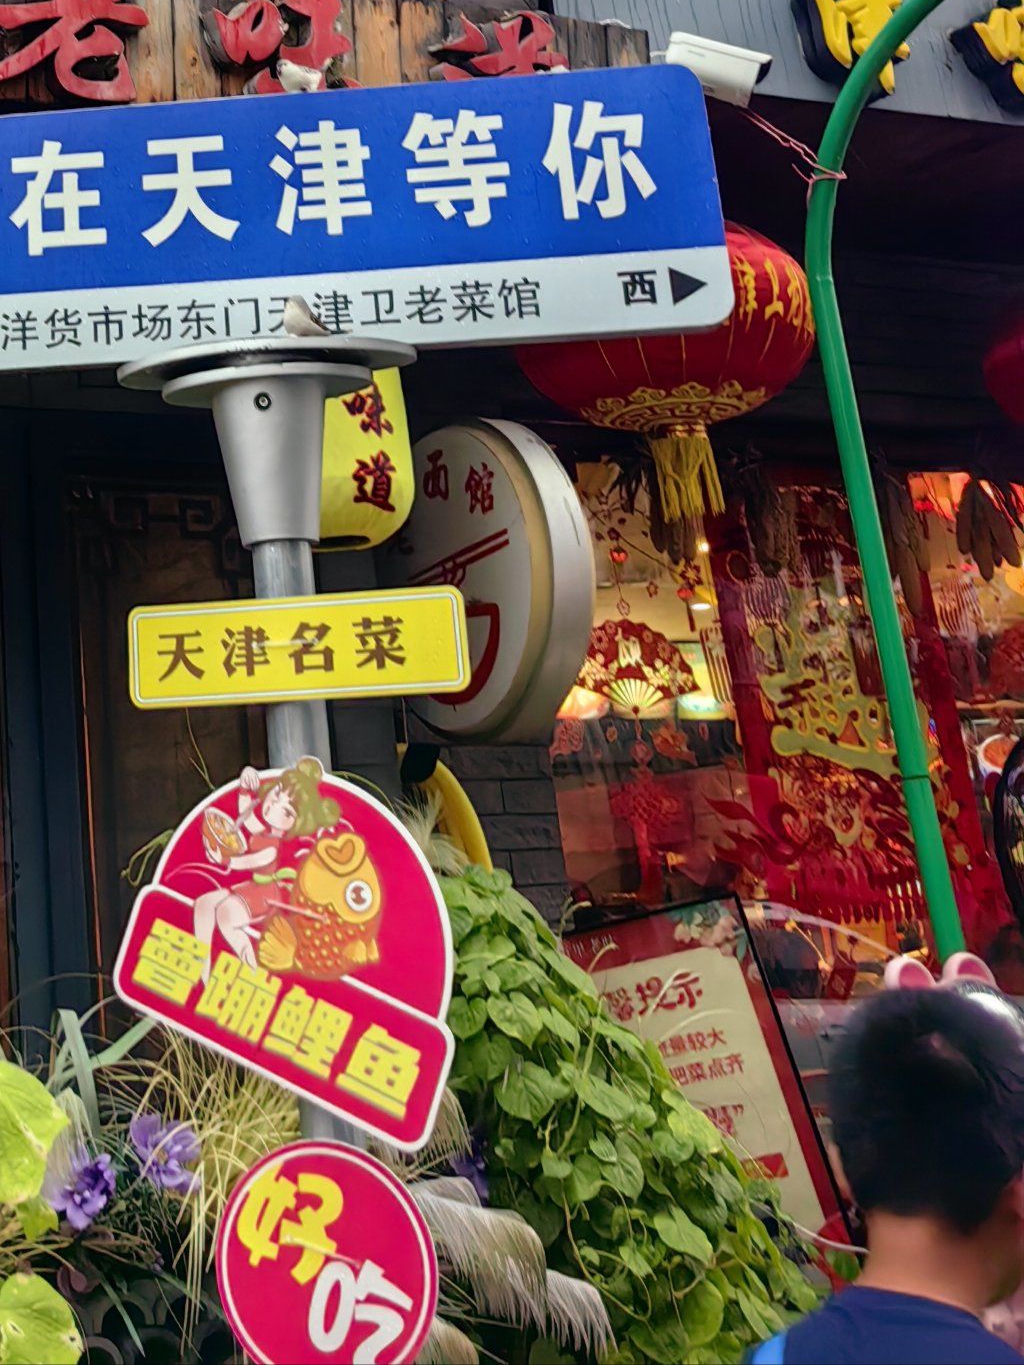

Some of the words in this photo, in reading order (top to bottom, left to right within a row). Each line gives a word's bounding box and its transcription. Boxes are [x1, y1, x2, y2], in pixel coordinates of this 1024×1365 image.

[617, 269, 658, 307] 西
[156, 614, 409, 683] 天津名菜
